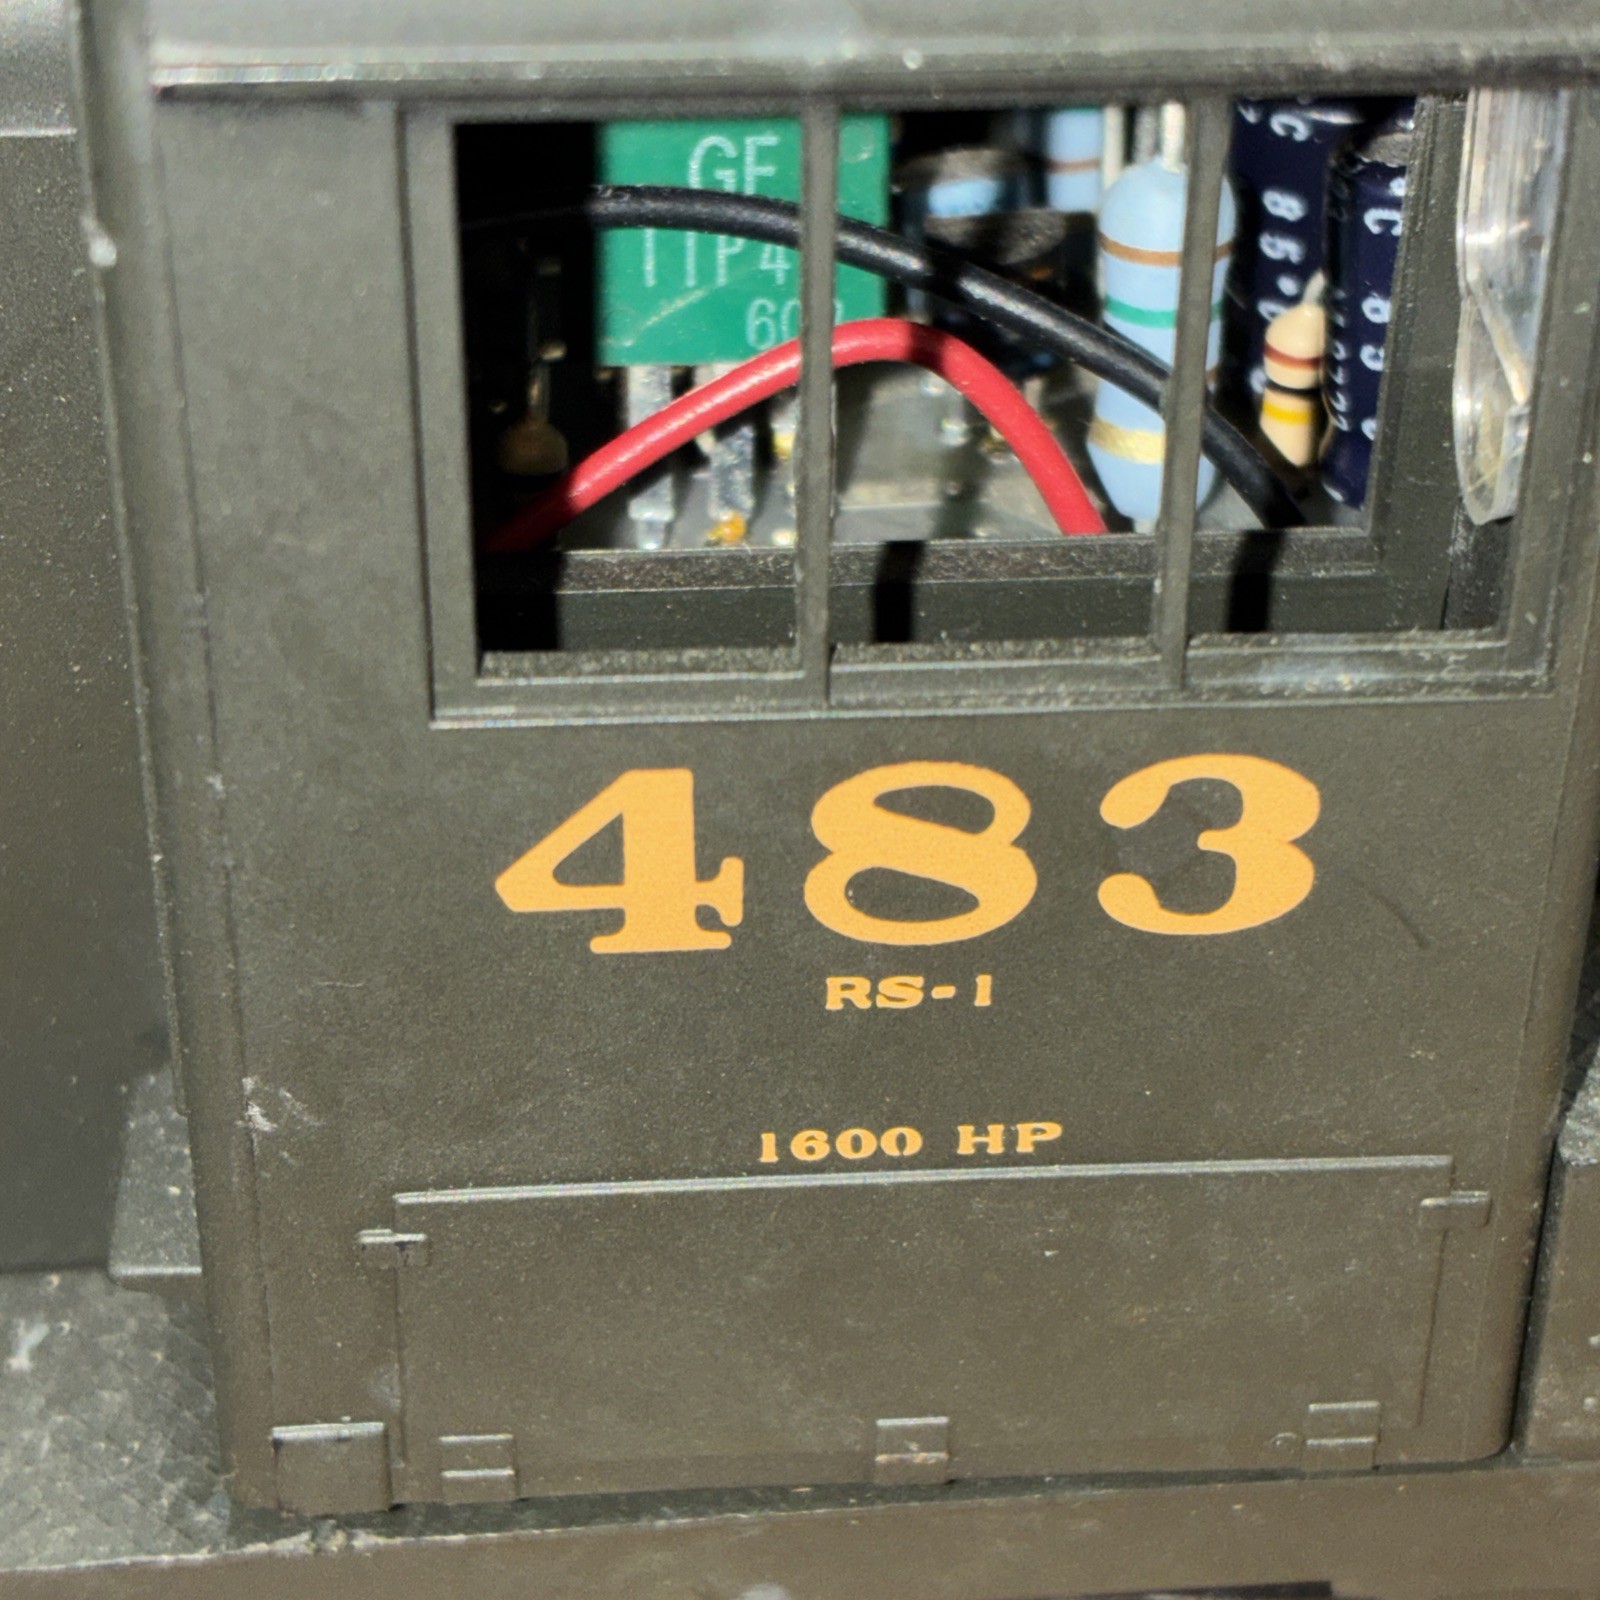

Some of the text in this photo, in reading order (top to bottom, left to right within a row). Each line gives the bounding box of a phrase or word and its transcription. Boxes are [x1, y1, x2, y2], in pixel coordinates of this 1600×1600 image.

[495, 754, 1321, 954] 483
[825, 974, 992, 1010] RS-1
[760, 1122, 1062, 1163] 1600 HP
